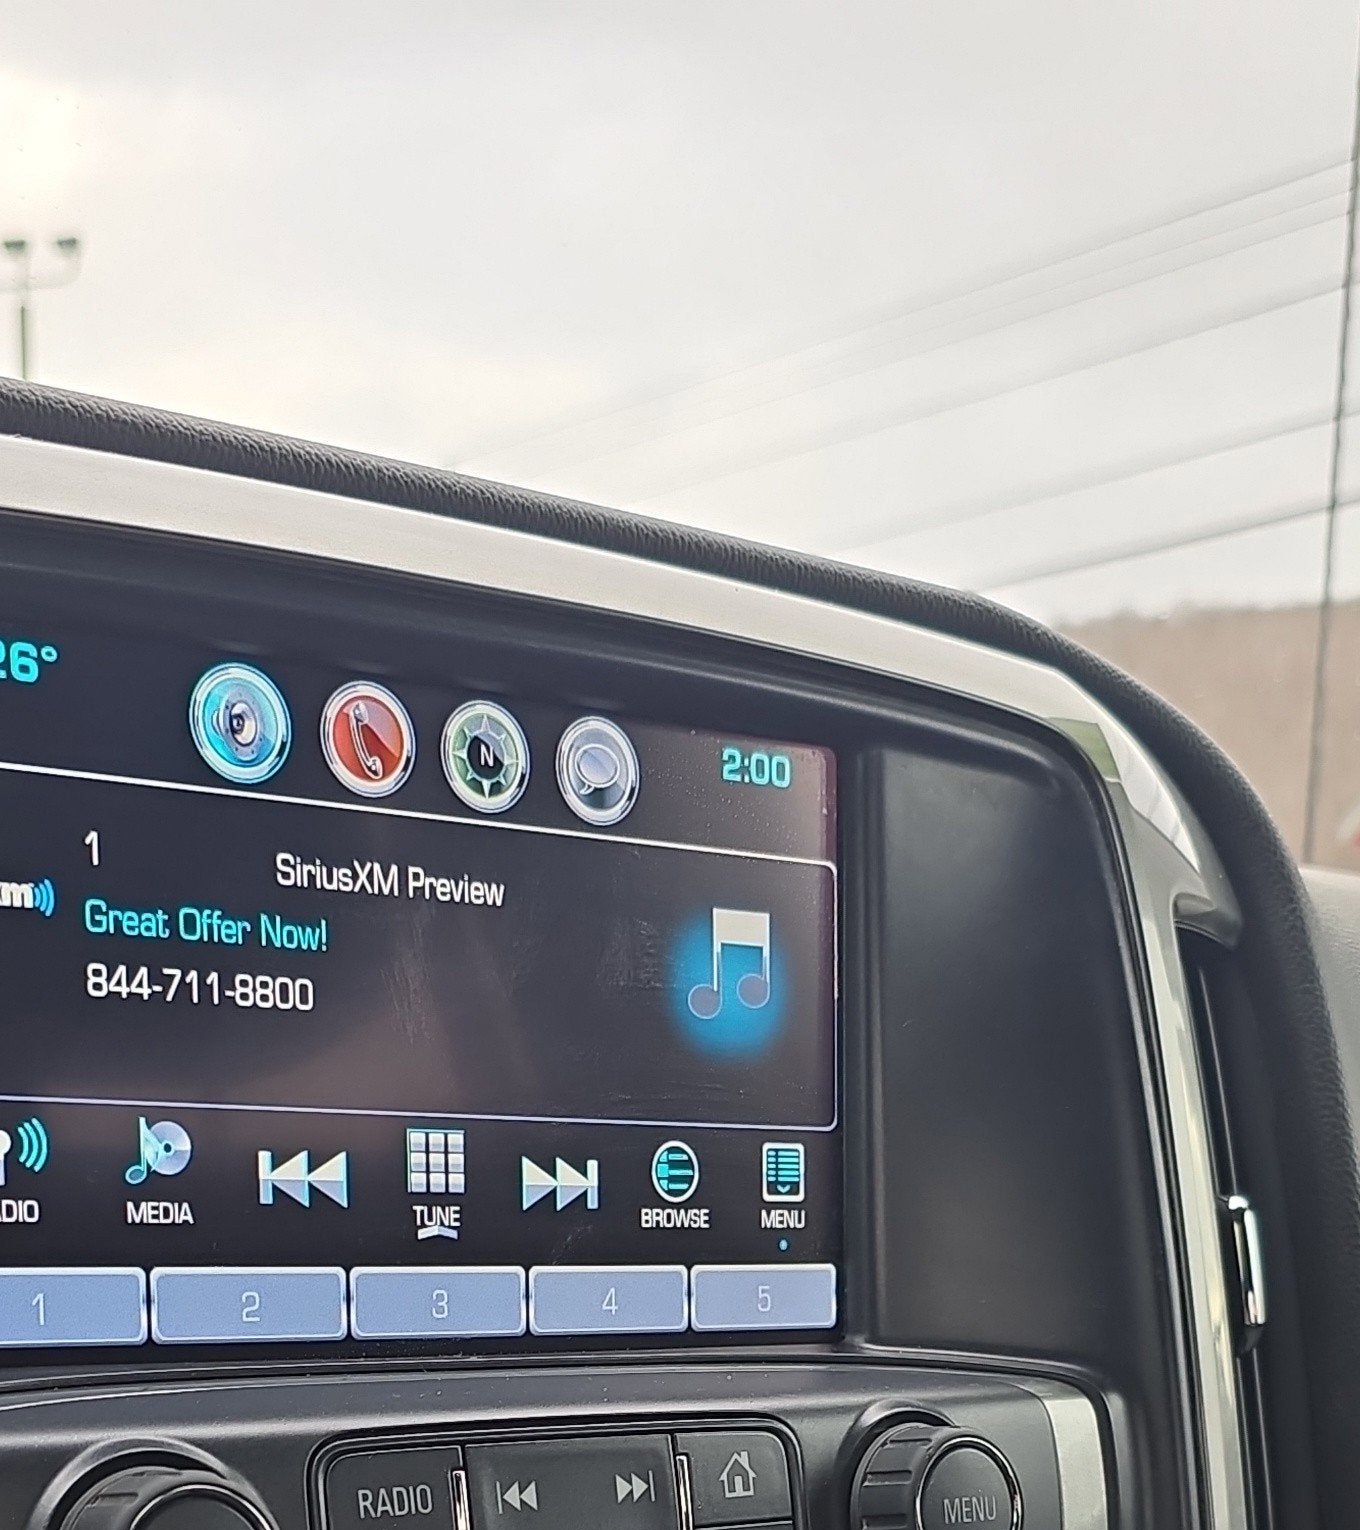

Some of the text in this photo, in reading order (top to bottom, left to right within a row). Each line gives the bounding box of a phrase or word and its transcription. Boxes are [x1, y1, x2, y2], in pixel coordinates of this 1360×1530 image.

[480, 743, 494, 767] N
[722, 748, 790, 788] 2:00
[84, 830, 100, 866] 1
[275, 851, 505, 907] SiriusXM Preview
[84, 899, 327, 951] Great Offer Now!
[86, 962, 315, 1011] 844-711-8800
[127, 1200, 194, 1226] MEDIA
[413, 1205, 462, 1229] TUNE
[641, 1207, 710, 1231] BROWSE
[760, 1207, 805, 1231] MENU
[31, 1292, 47, 1326] 1
[240, 1291, 261, 1323] 2
[431, 1289, 450, 1320] 3
[601, 1287, 620, 1318] 4
[756, 1284, 772, 1314] 5
[357, 1484, 434, 1519] RADIO
[943, 1495, 997, 1526] MENU
